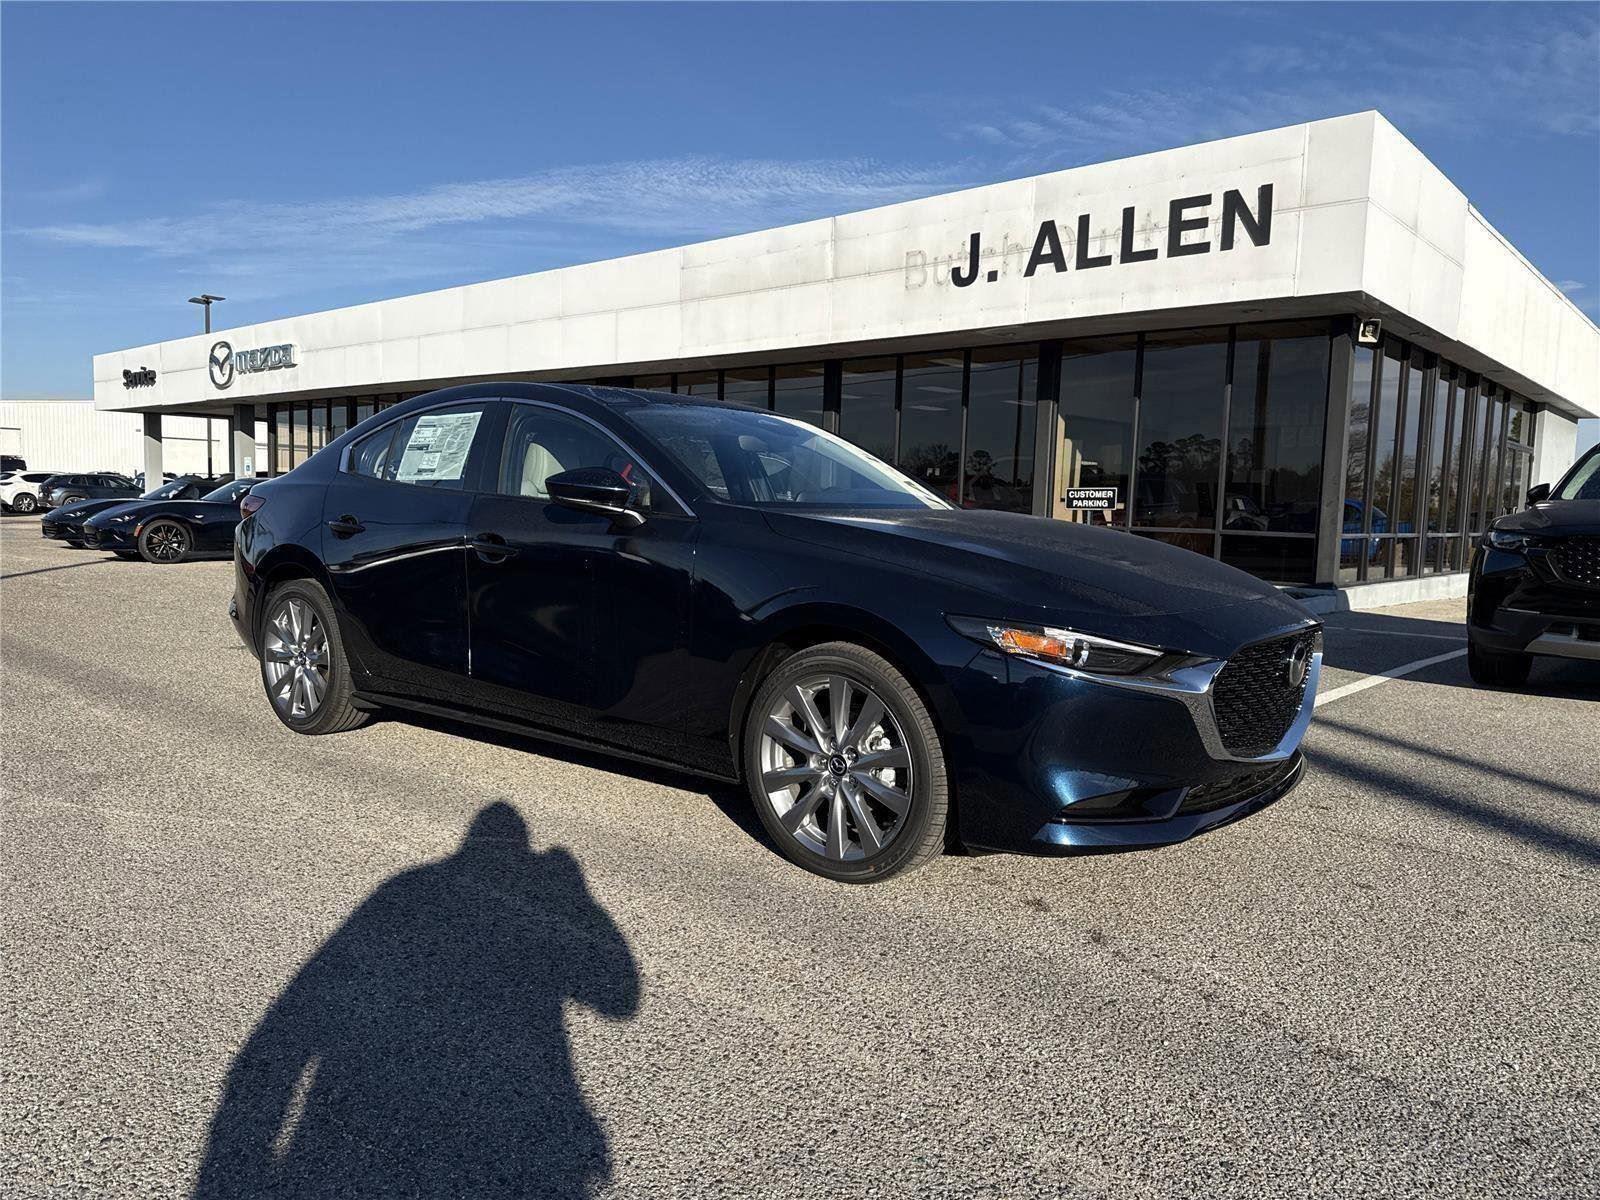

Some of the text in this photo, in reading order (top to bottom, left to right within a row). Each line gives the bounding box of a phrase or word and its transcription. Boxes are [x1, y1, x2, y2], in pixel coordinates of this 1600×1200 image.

[951, 232, 998, 288] J.
[1024, 183, 1274, 277] ALLEN
[122, 366, 157, 390] Service
[1068, 490, 1113, 498] CUSTOMER
[1072, 499, 1108, 507] PARKING
